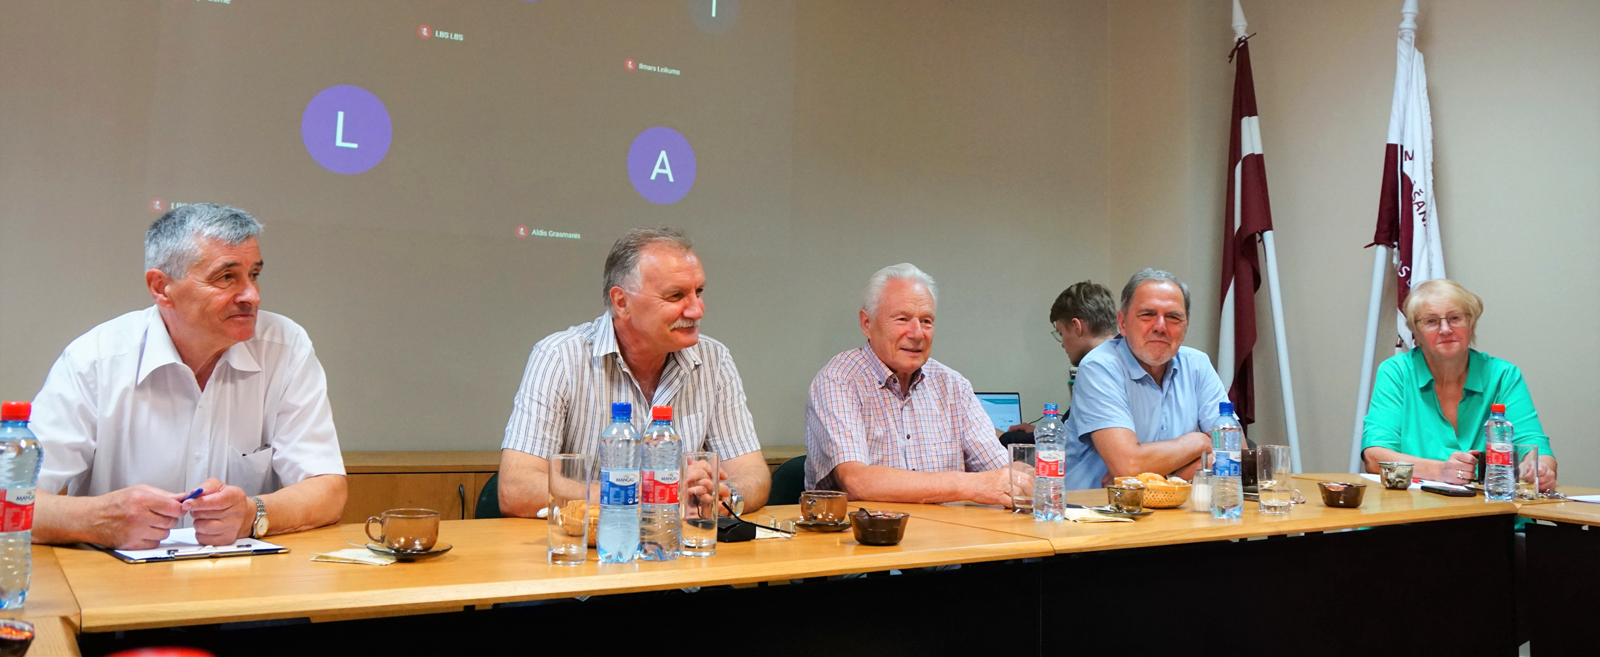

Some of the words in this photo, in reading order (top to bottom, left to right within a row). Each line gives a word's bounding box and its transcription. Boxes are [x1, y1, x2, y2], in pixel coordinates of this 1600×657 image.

[435, 30, 449, 39] LBS
[450, 32, 463, 41] LBS
[335, 111, 358, 148] L
[650, 150, 674, 182] A
[548, 230, 581, 239] Grasmanis
